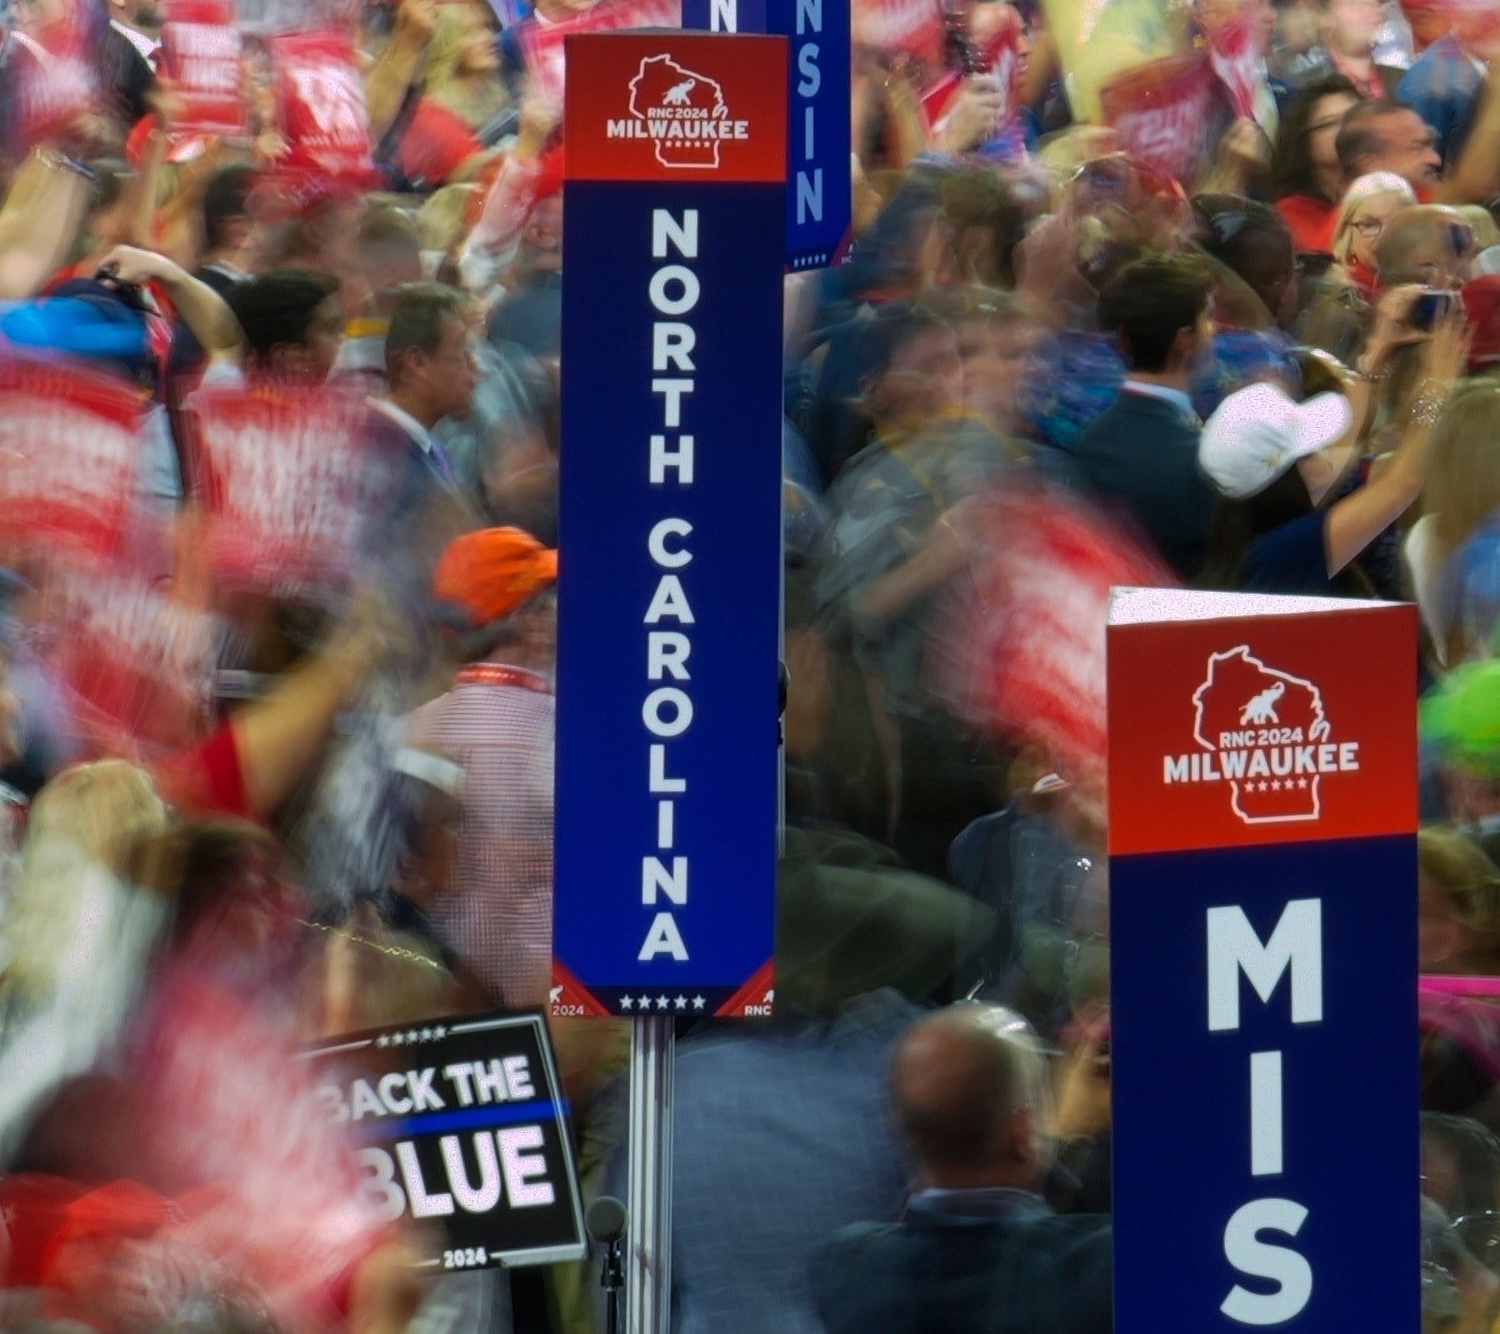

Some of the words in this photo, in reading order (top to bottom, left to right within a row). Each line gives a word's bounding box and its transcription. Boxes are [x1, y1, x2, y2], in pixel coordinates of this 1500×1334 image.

[648, 108, 674, 120] RNC
[676, 107, 708, 120] 2024
[605, 119, 748, 140] MILWAUKEE
[648, 208, 700, 486] NORTH
[637, 517, 695, 963] CAROLINA
[1218, 731, 1251, 749] RNC
[1255, 727, 1303, 745] 2024
[1162, 741, 1359, 785] MILWAUKEE
[552, 1005, 584, 1016] 2024
[744, 1005, 772, 1016] RNC
[318, 1069, 447, 1124] BACK
[444, 1055, 537, 1104] THE
[353, 1125, 556, 1224] BLUE
[443, 1246, 488, 1269] 2024
